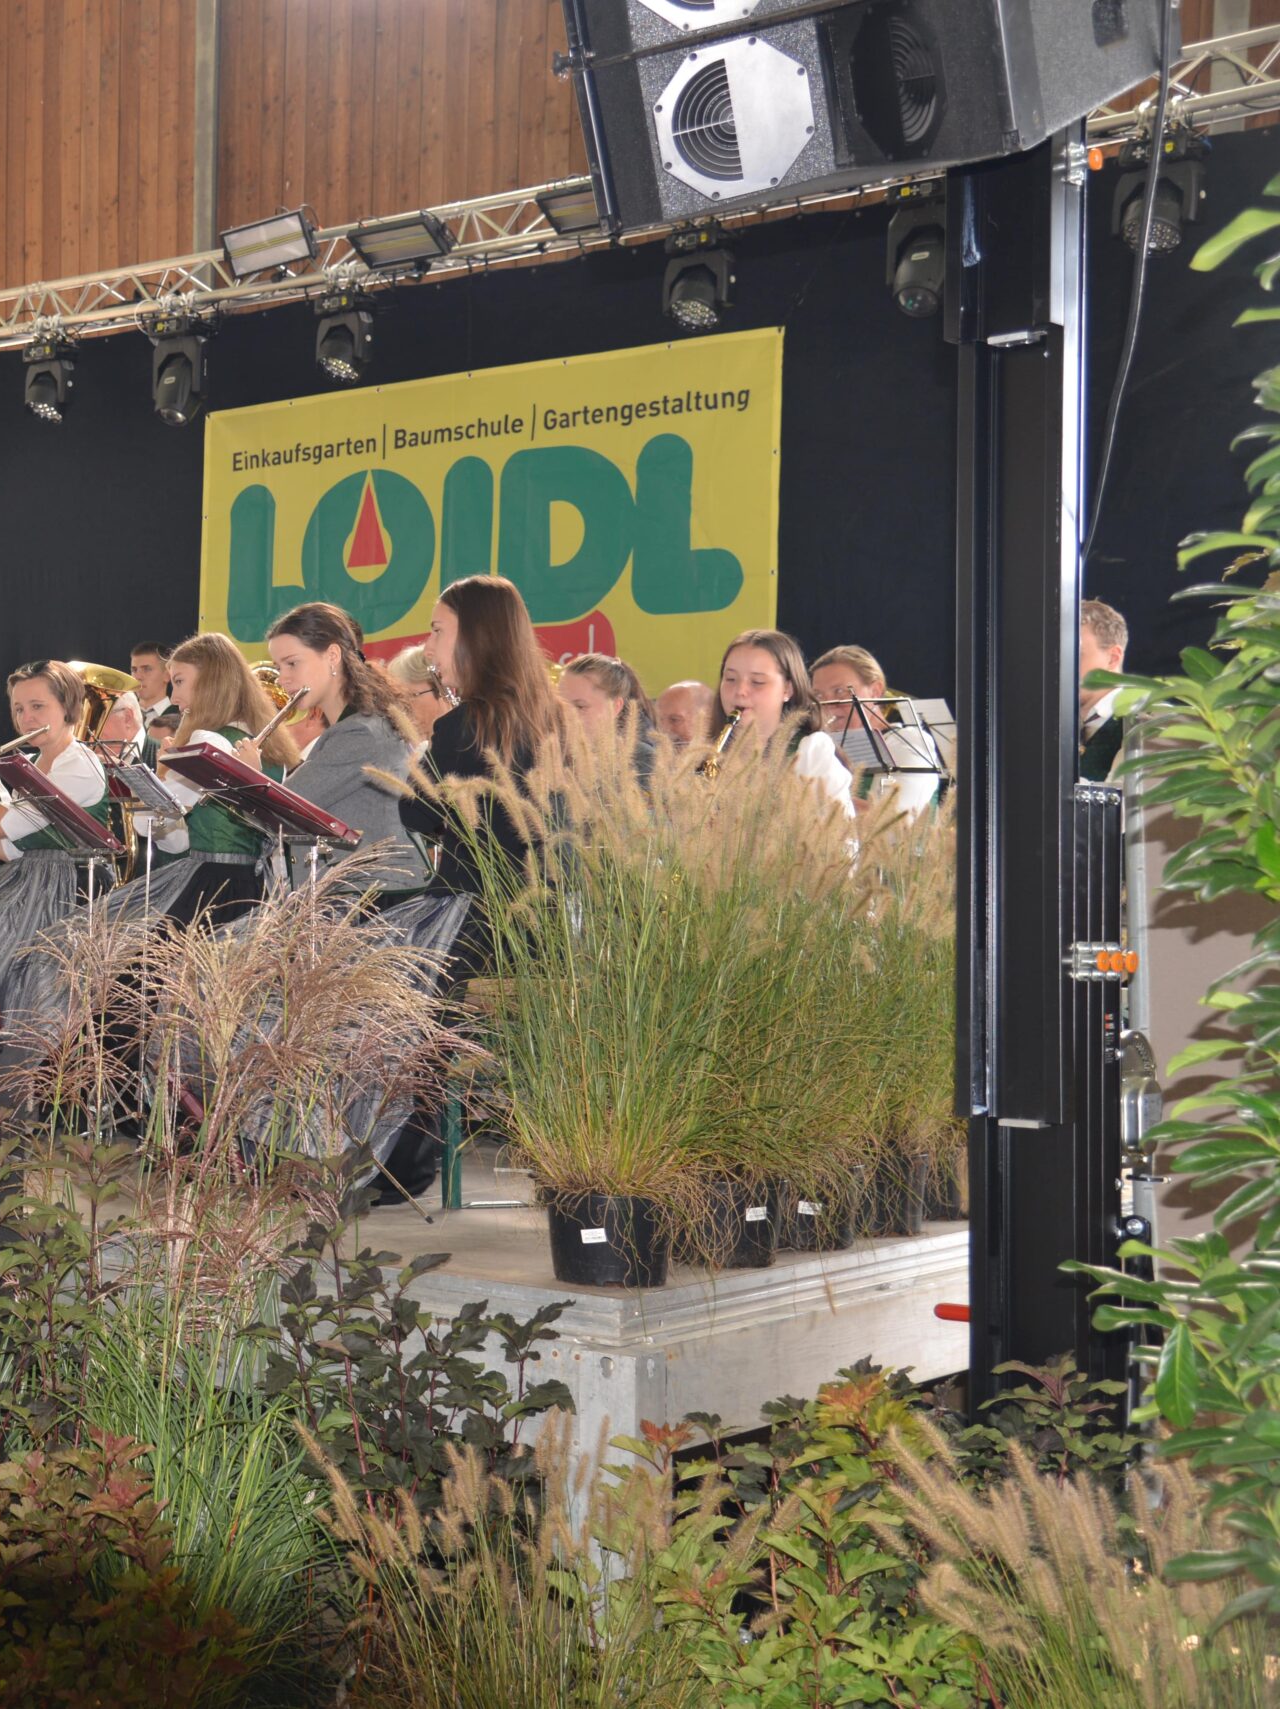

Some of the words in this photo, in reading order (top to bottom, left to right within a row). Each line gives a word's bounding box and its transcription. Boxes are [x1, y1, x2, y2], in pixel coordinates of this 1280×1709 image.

[232, 437, 377, 472] Einkaufsgarten
[394, 414, 525, 450] Baumschule
[543, 388, 751, 431] Gartengestaltung
[228, 433, 744, 642] LOIDL
